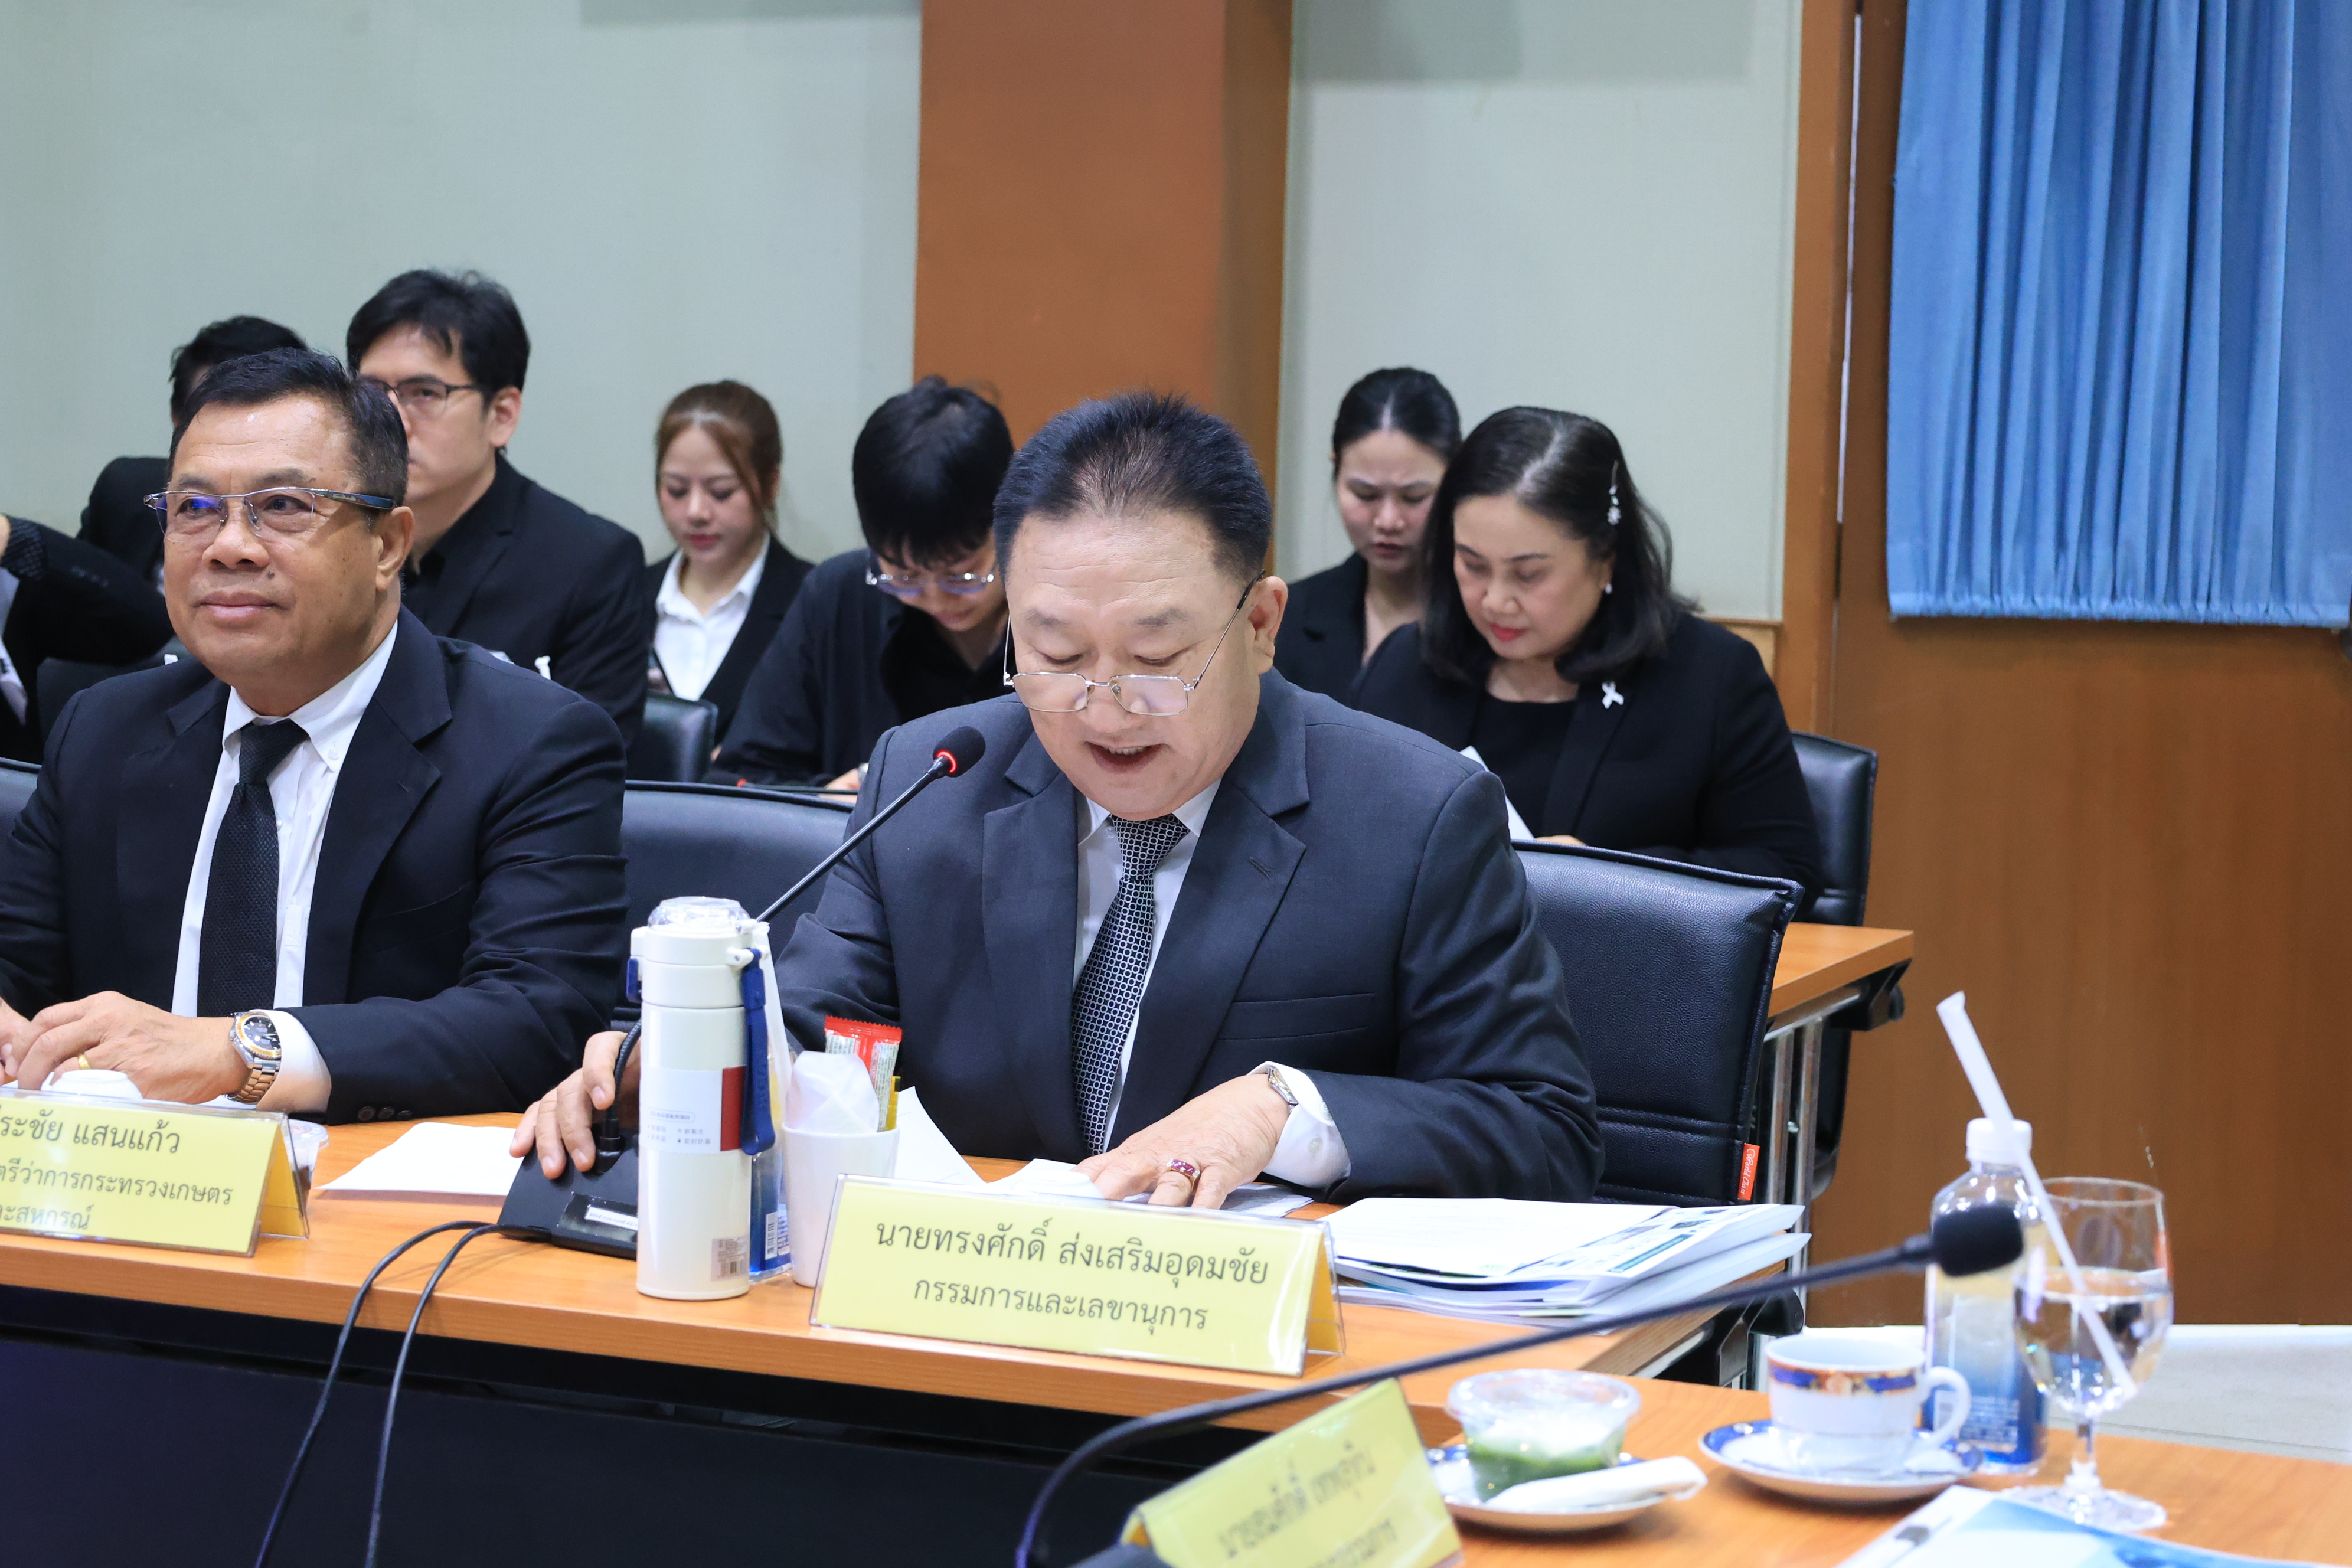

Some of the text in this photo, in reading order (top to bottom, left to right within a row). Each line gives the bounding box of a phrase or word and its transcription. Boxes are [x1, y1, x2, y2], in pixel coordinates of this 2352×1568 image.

[0, 1109, 181, 1154] ระชัย แสนแก้ว
[1740, 1148, 1756, 1195] World Class
[0, 1204, 92, 1230] ะสหกรณ์
[876, 1217, 1269, 1288] นายทรงศักดิ์ ส่งเสริมอุดมชัย
[914, 1277, 1208, 1337] กรรมการและเลขานุการ
